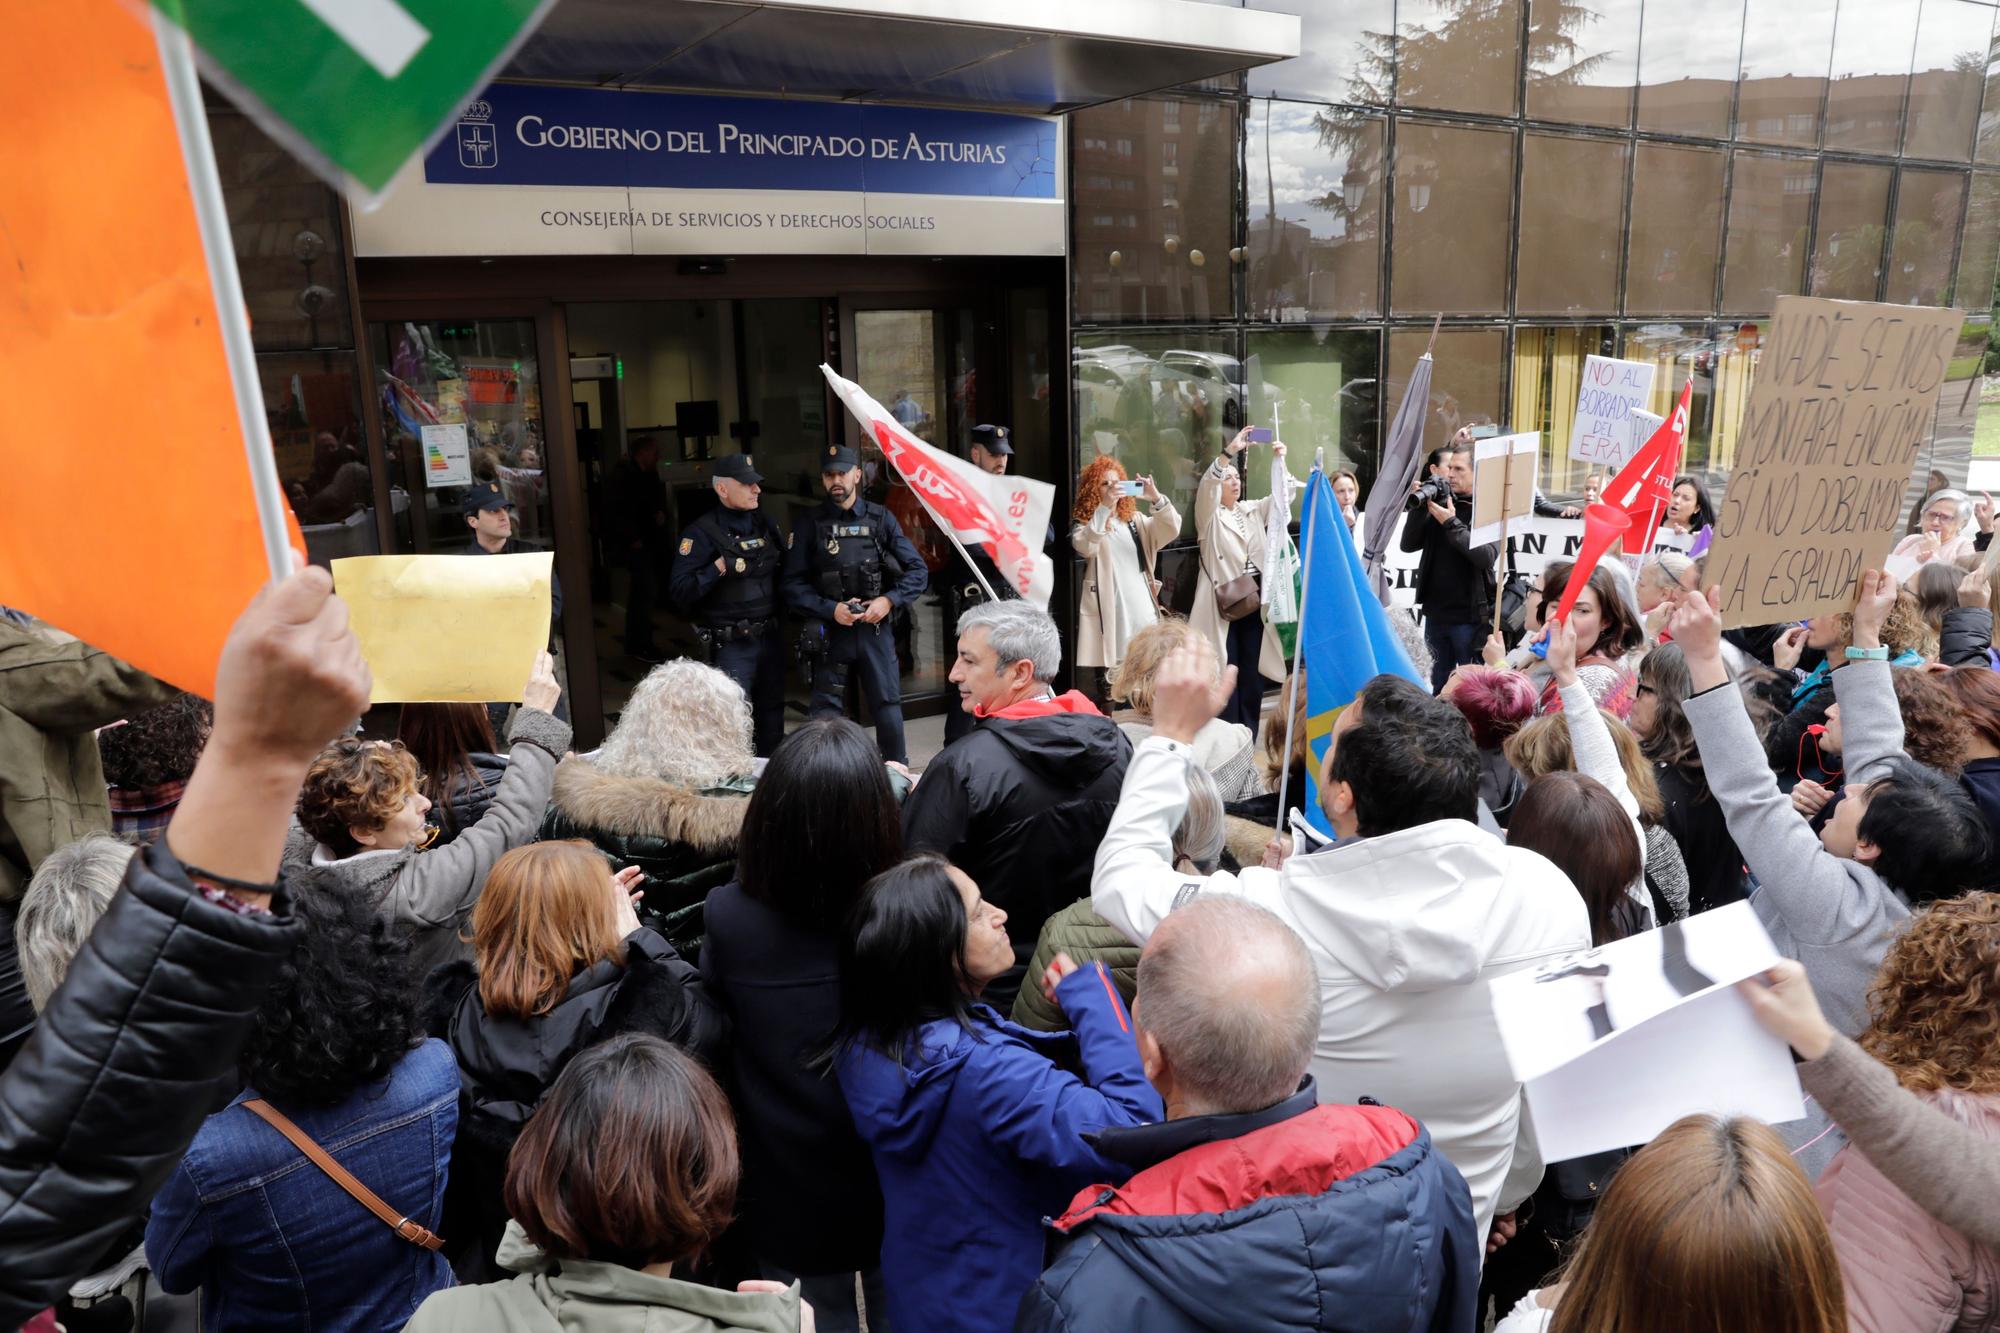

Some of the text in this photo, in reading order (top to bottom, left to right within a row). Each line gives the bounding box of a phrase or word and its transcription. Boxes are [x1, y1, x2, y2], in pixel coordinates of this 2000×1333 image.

[516, 115, 1006, 164] GOBIERNO DEL PRINCIPADO DE ASTURIAS
[540, 208, 936, 230] CONSEJERÍA DE SERVICIOS Y DERECHOS SOCIALES
[1845, 316, 1902, 391] SE
[1587, 361, 1641, 388] NO AL
[1592, 420, 1614, 437] DEL
[1579, 434, 1622, 462] ERA
[1755, 471, 1800, 536] NO
[1801, 475, 1910, 535] DOBLAMOS
[1719, 547, 1864, 613] LA ESPALDA
